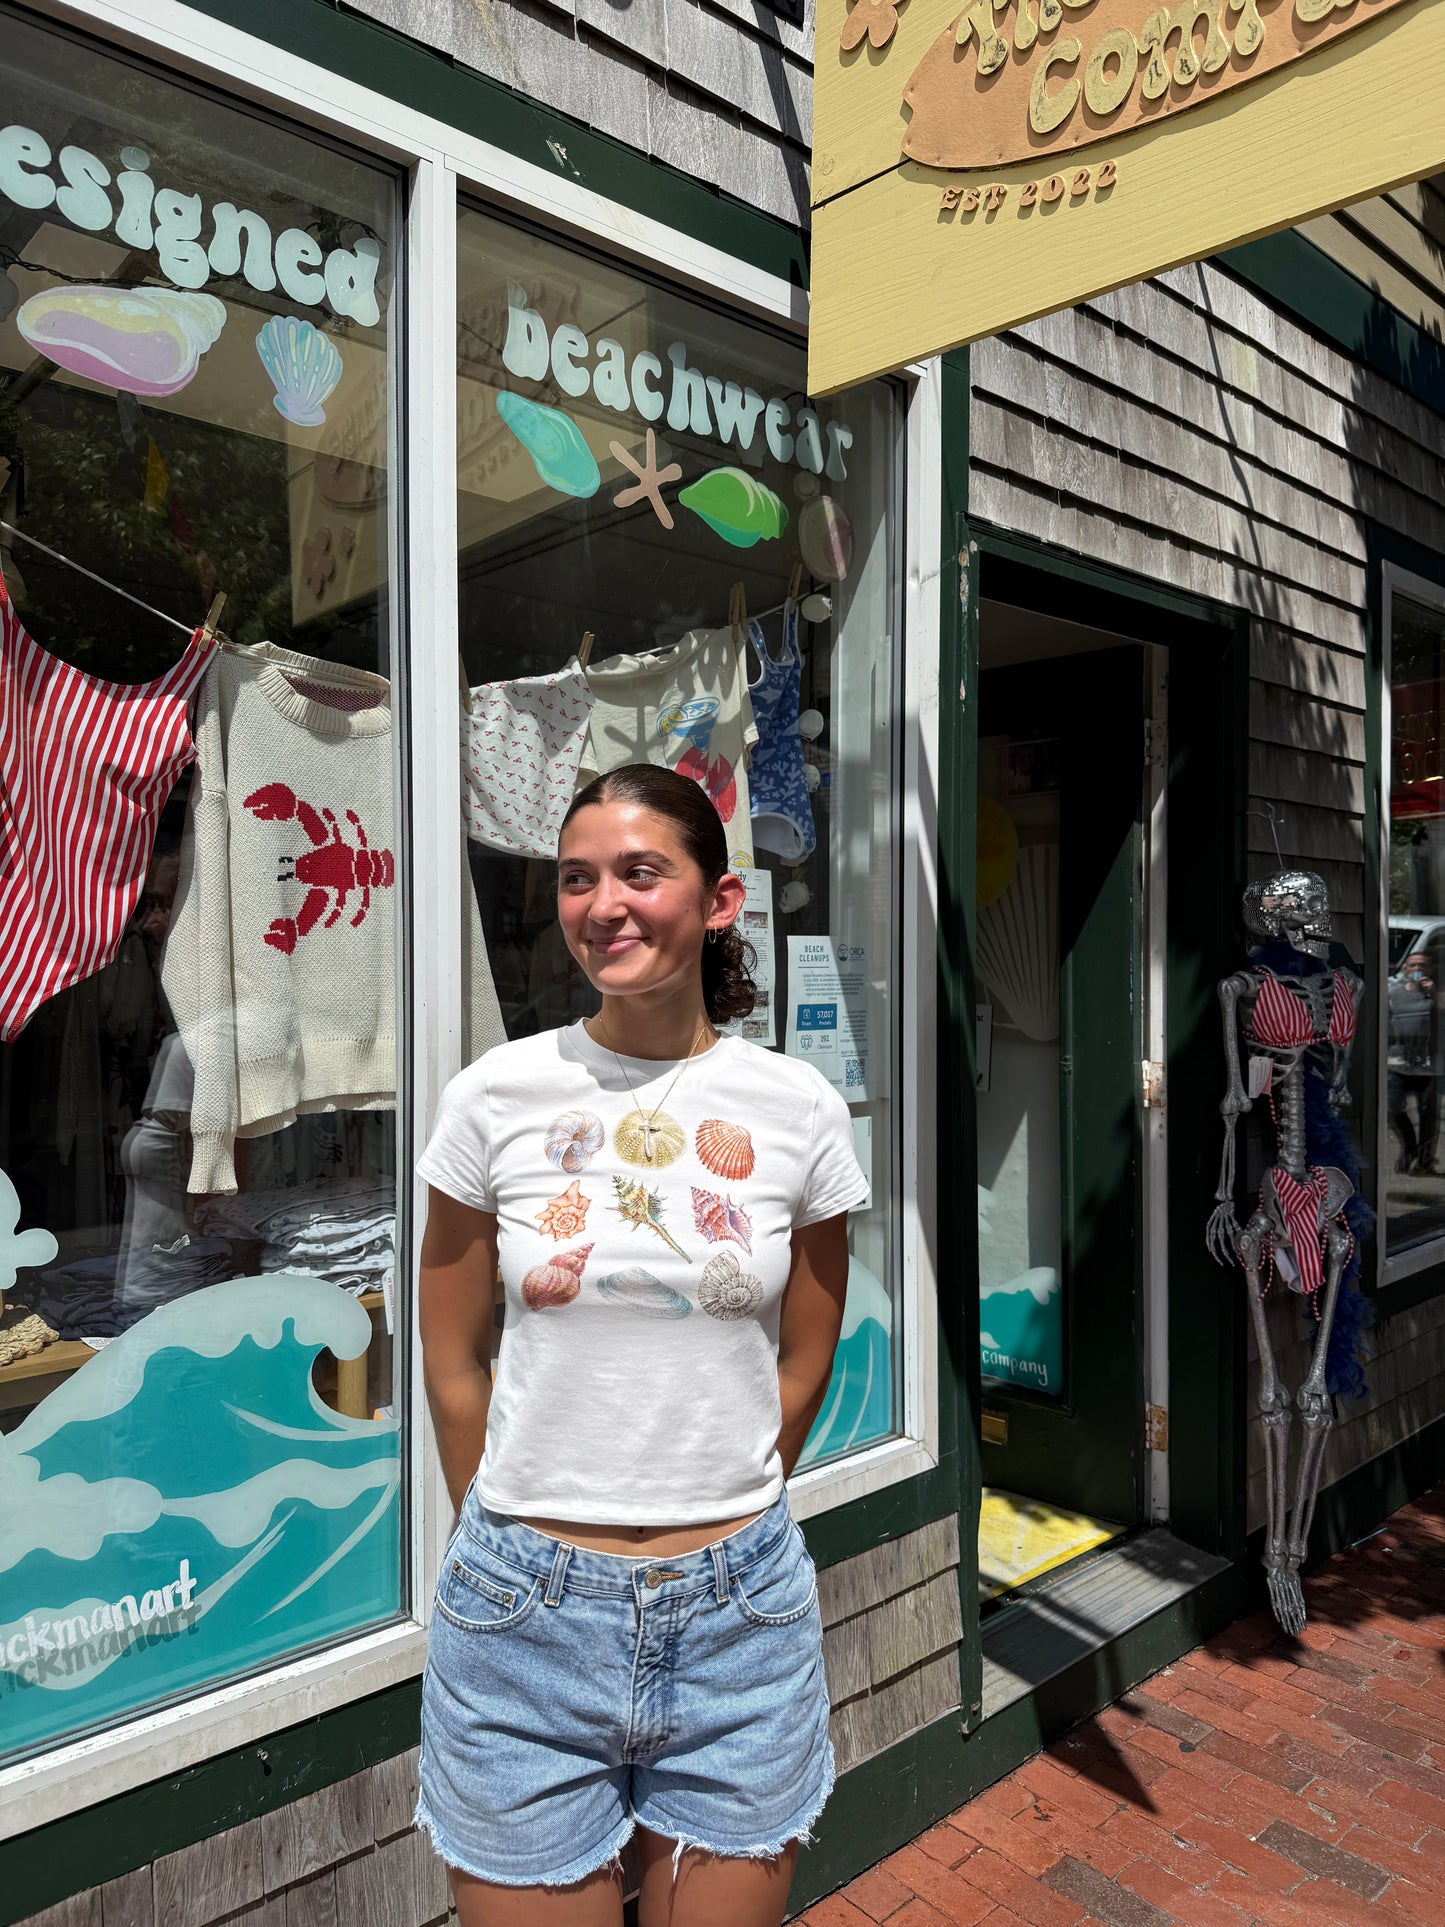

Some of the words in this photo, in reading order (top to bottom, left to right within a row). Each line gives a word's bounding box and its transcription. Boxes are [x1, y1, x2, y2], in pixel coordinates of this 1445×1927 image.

[939, 184, 1008, 211] EST
[1020, 160, 1117, 207] 2022
[0, 125, 381, 327] esigned
[502, 278, 853, 482] beachwear
[799, 954, 830, 962] CLEANUPS
[804, 945, 824, 953] BEACH
[820, 1034, 830, 1043] 192
[982, 1350, 1049, 1386] company
[0, 1558, 197, 1668] ckmanart
